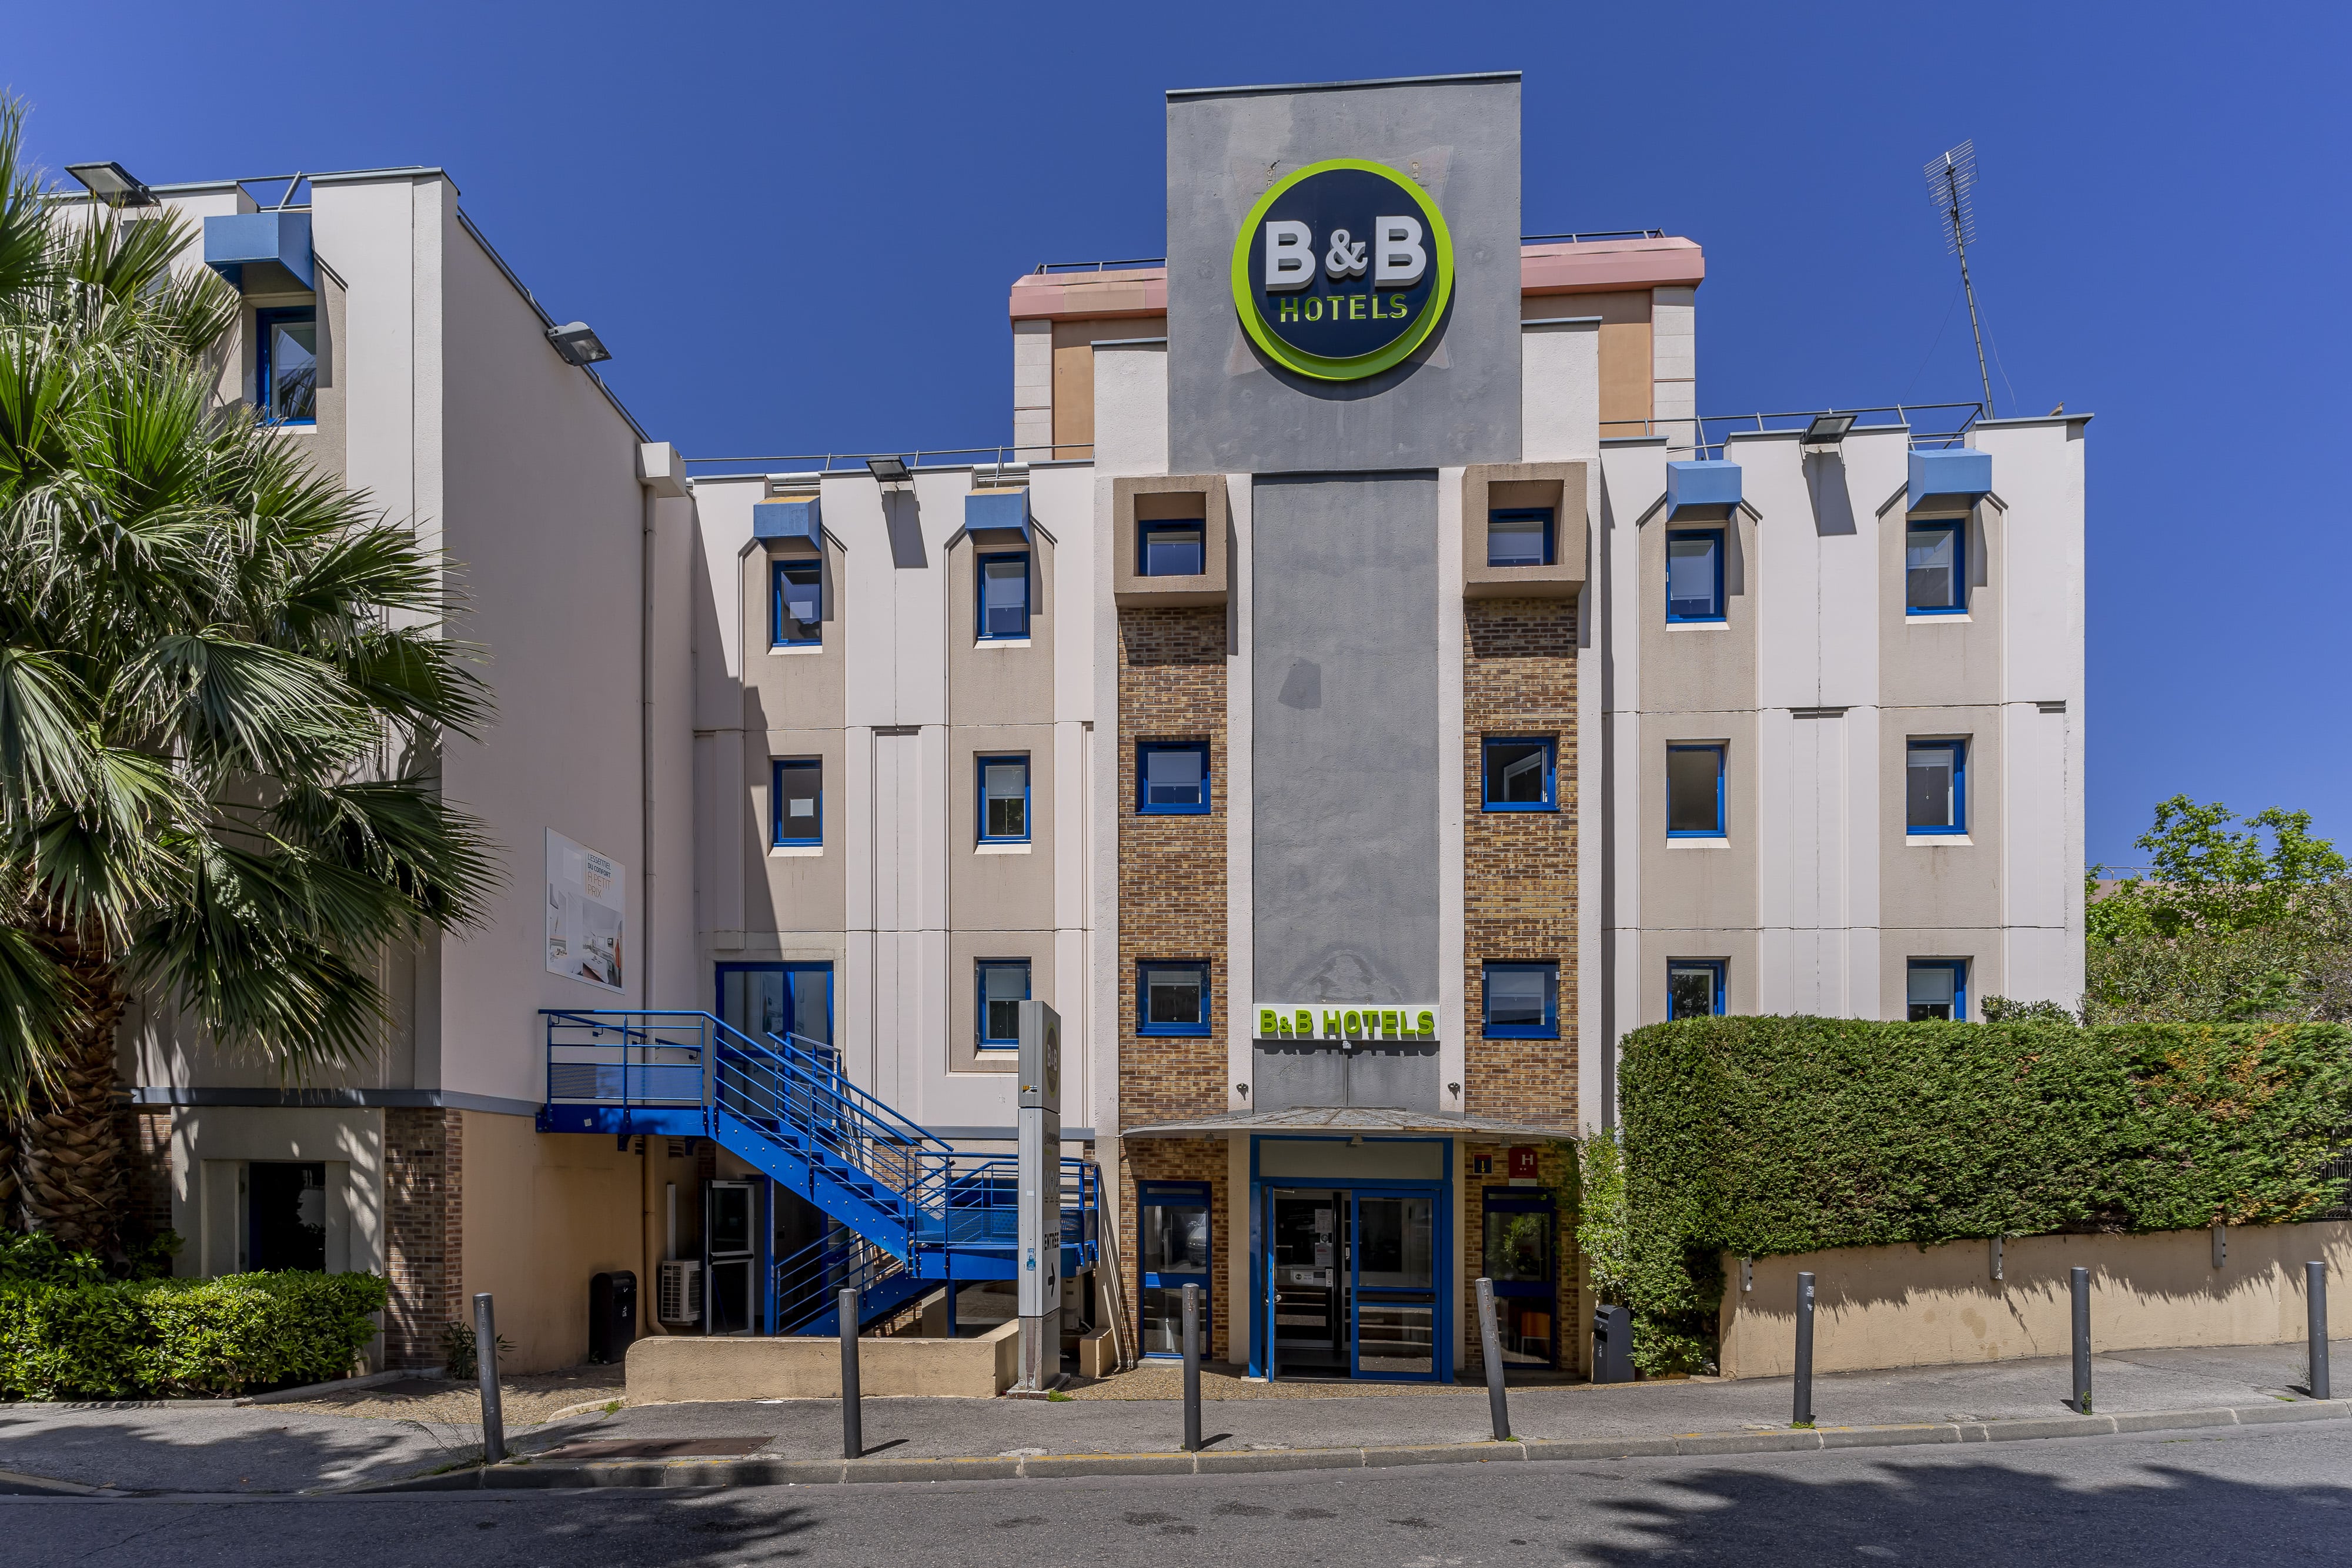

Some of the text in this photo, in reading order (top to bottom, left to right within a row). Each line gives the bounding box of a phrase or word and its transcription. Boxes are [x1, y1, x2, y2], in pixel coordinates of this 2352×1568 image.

[1265, 216, 1426, 291] B&B
[1280, 294, 1408, 322] HOTELS
[588, 853, 611, 870] L'ESSENTIEL
[594, 865, 611, 878] CONFORT
[594, 874, 611, 890] PETIT
[588, 884, 602, 900] PRIX
[1260, 1009, 1434, 1035] B&B HOTELS
[1522, 1154, 1534, 1165] H
[1044, 1226, 1059, 1251] ENTRÉE
